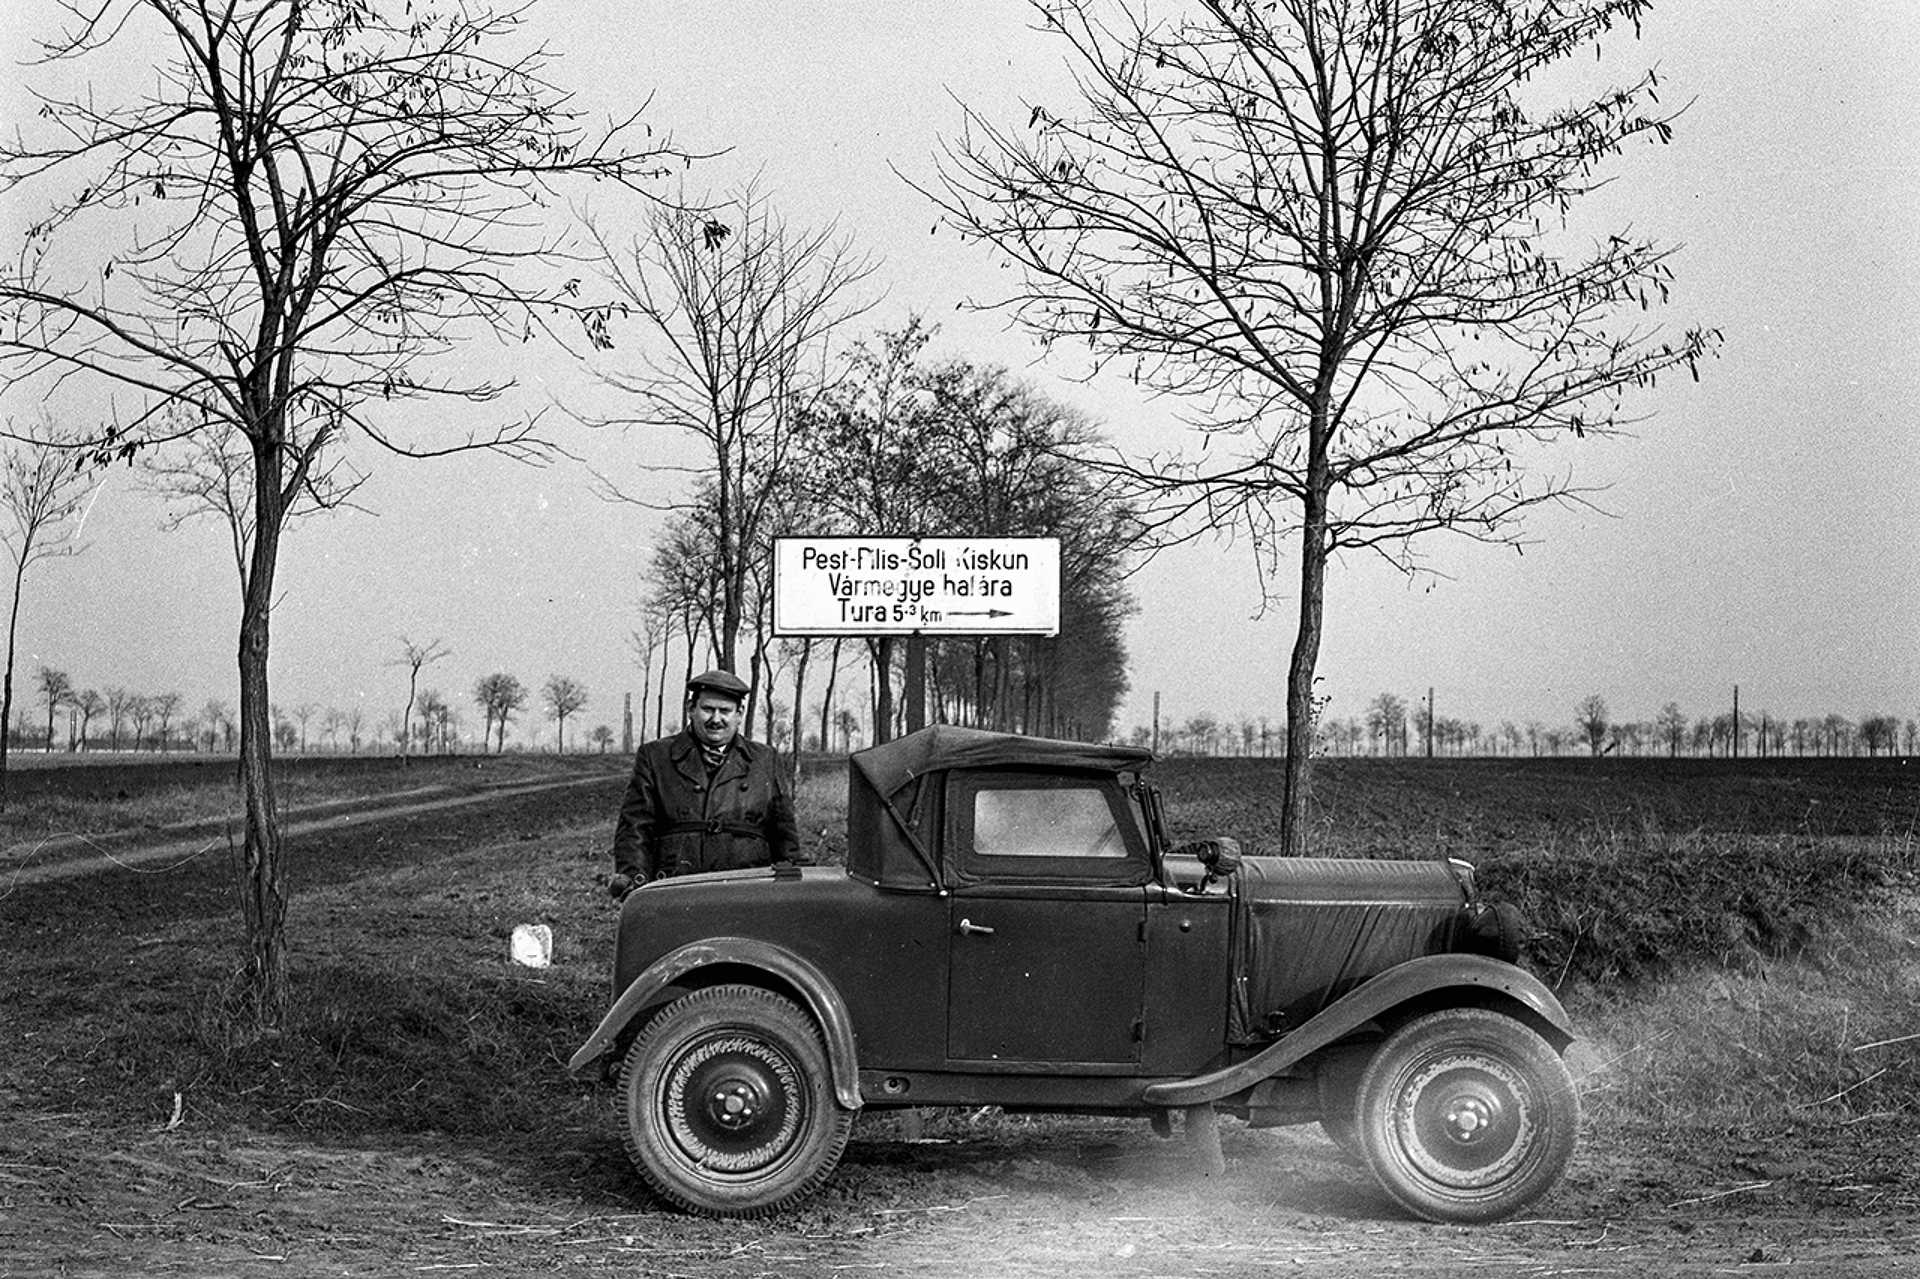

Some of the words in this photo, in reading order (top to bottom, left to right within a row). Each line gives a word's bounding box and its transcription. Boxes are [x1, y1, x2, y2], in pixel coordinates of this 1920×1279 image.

[828, 572, 935, 603] Vármegye
[837, 598, 887, 622] Tura
[920, 605, 943, 623] km
